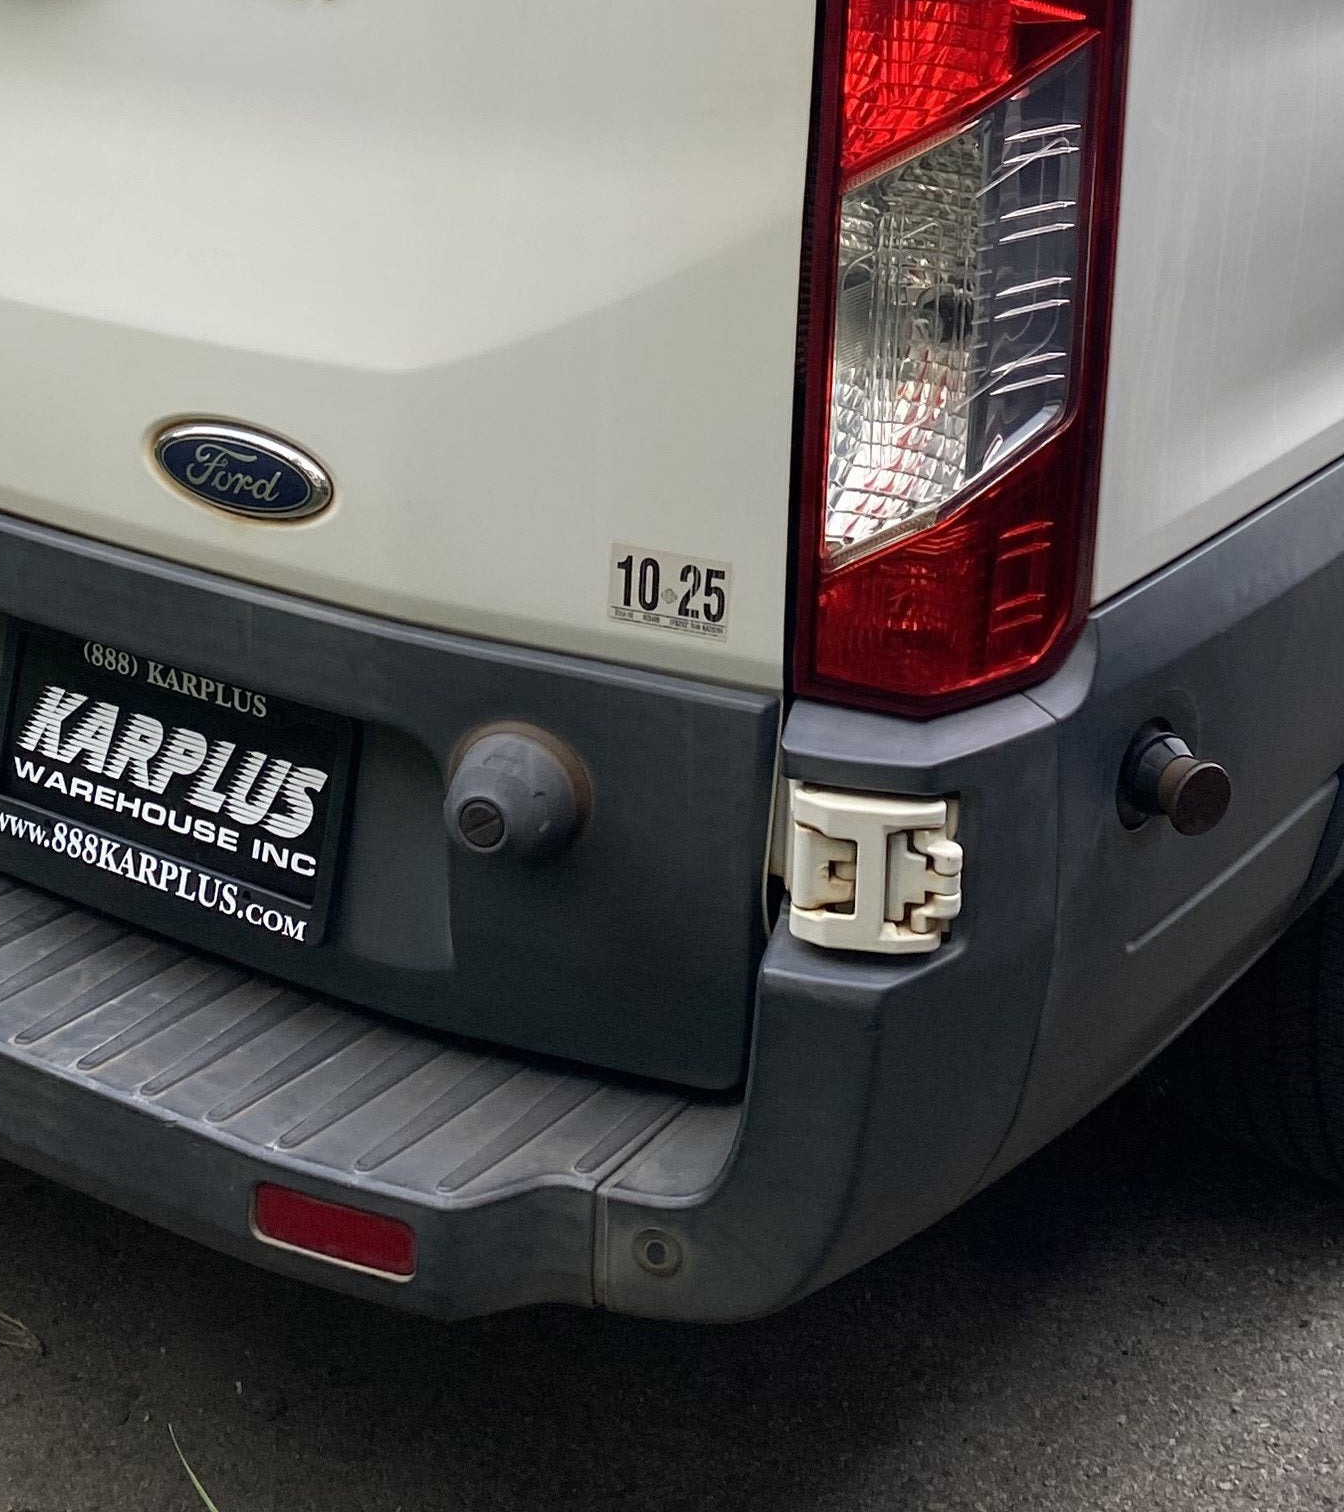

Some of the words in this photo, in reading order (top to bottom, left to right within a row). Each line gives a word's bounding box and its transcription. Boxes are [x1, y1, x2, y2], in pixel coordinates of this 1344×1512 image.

[186, 443, 282, 502] Ford
[617, 555, 660, 611] 10
[678, 564, 726, 623] 25
[83, 640, 138, 677] (888)
[147, 660, 268, 718] KARPLUS
[16, 685, 328, 838] KARPLUS
[14, 756, 241, 852] WAREHOUSE
[252, 838, 316, 876] INC
